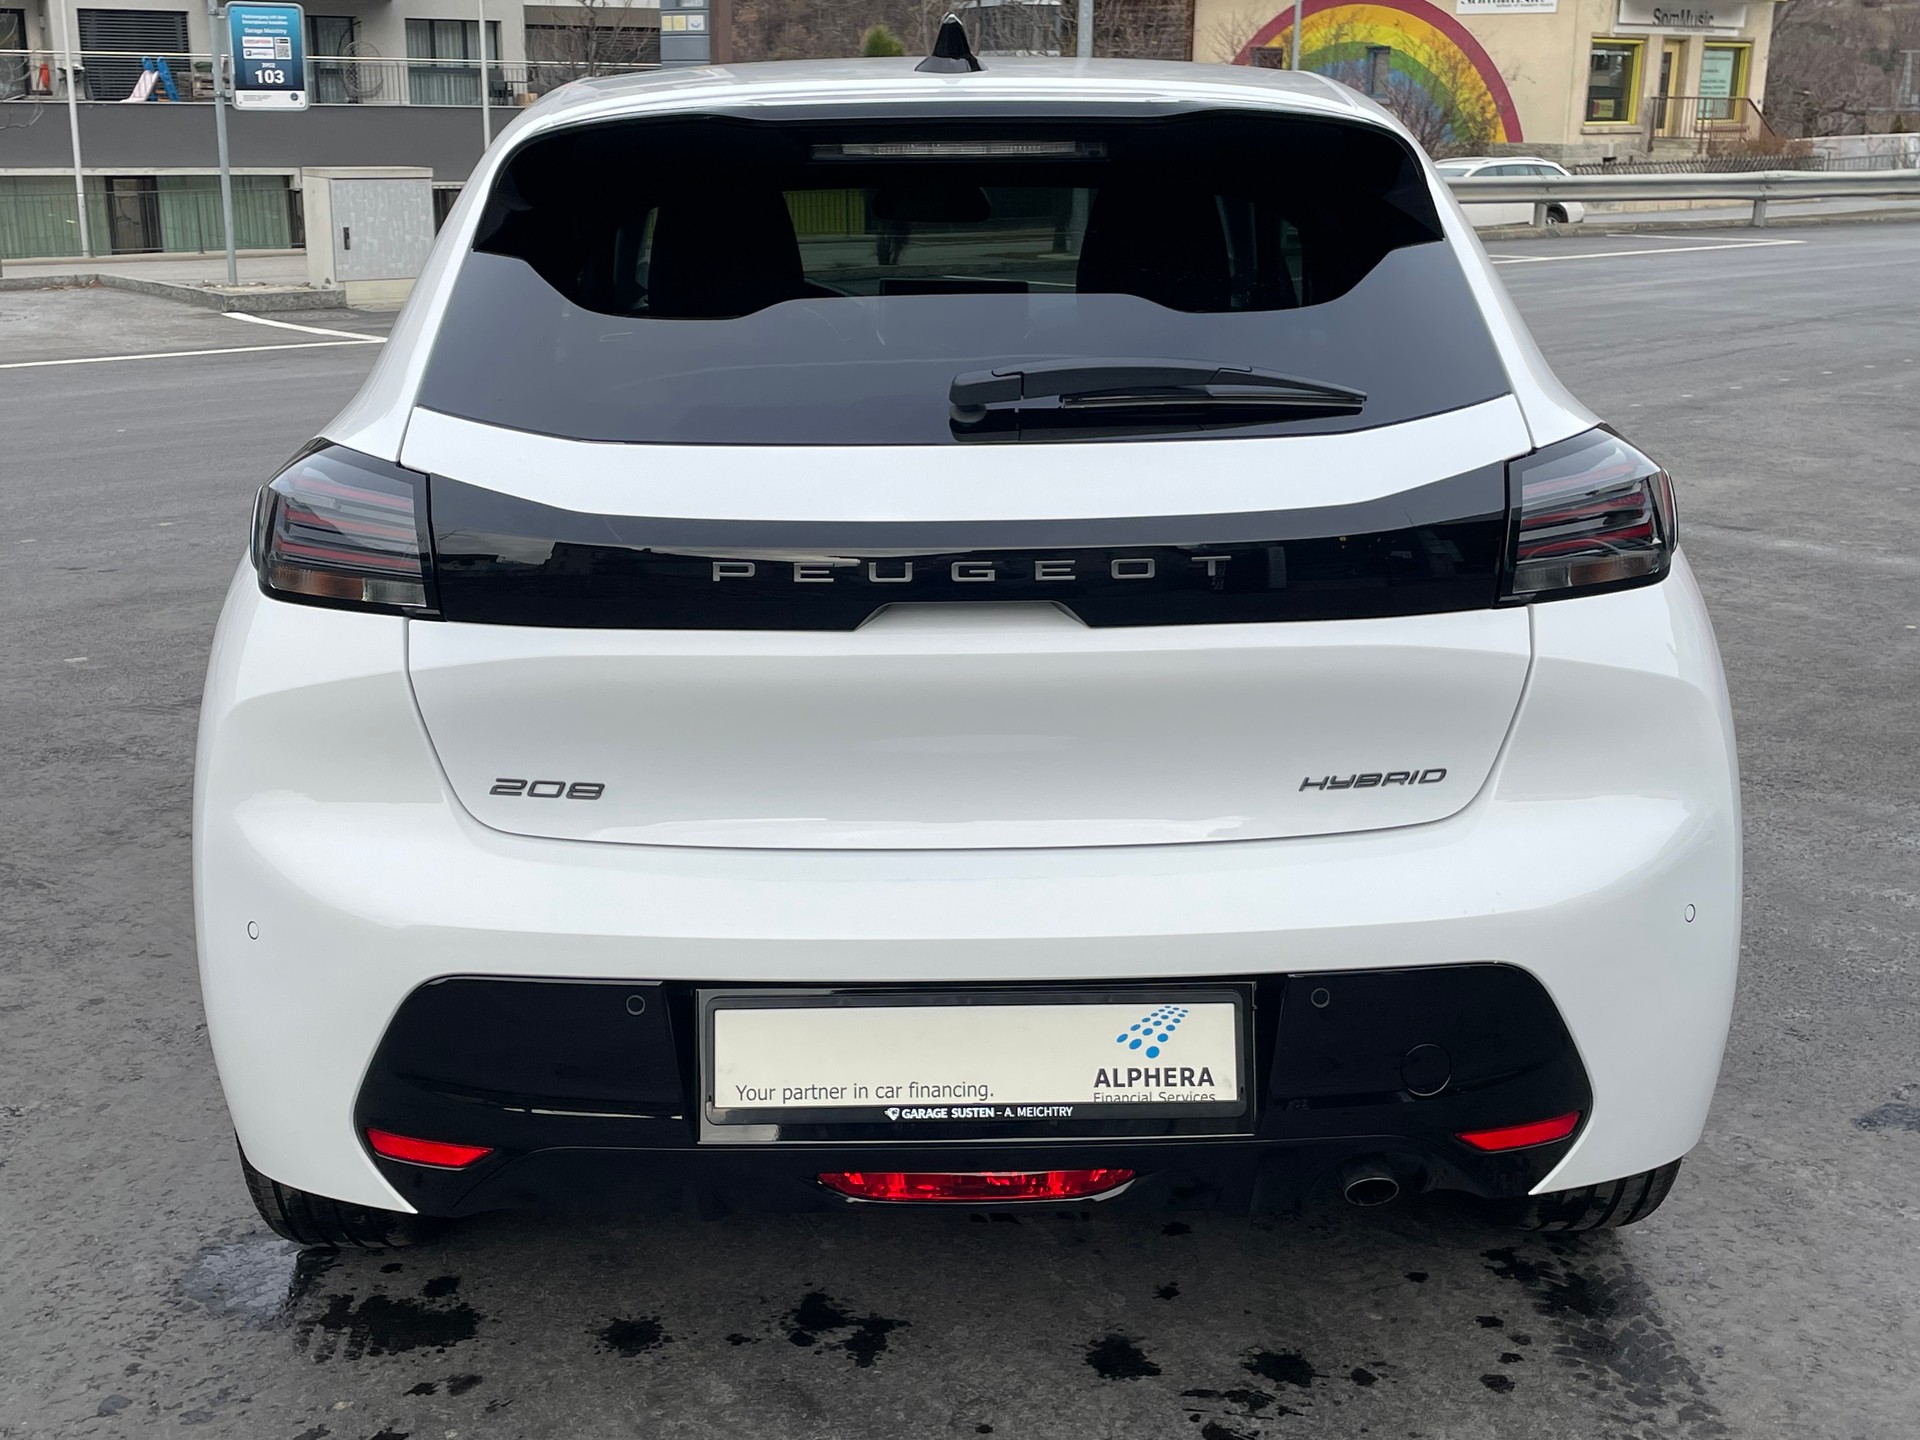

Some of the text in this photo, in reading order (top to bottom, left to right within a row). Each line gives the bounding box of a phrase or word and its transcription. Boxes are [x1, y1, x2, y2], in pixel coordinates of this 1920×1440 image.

[255, 69, 285, 84] 103
[712, 556, 1232, 582] PEUGEOT
[489, 778, 605, 800] 208
[1299, 768, 1447, 792] HYBRID
[1094, 1067, 1215, 1088] ALPHERA
[735, 1081, 994, 1104] Your partner in car financing.
[1093, 1091, 1216, 1103] Financial Services
[901, 1108, 948, 1119] GARAGE
[951, 1107, 995, 1118] SUSTEN
[1004, 1106, 1016, 1117] A.
[1017, 1106, 1074, 1117] MEICHTRY
